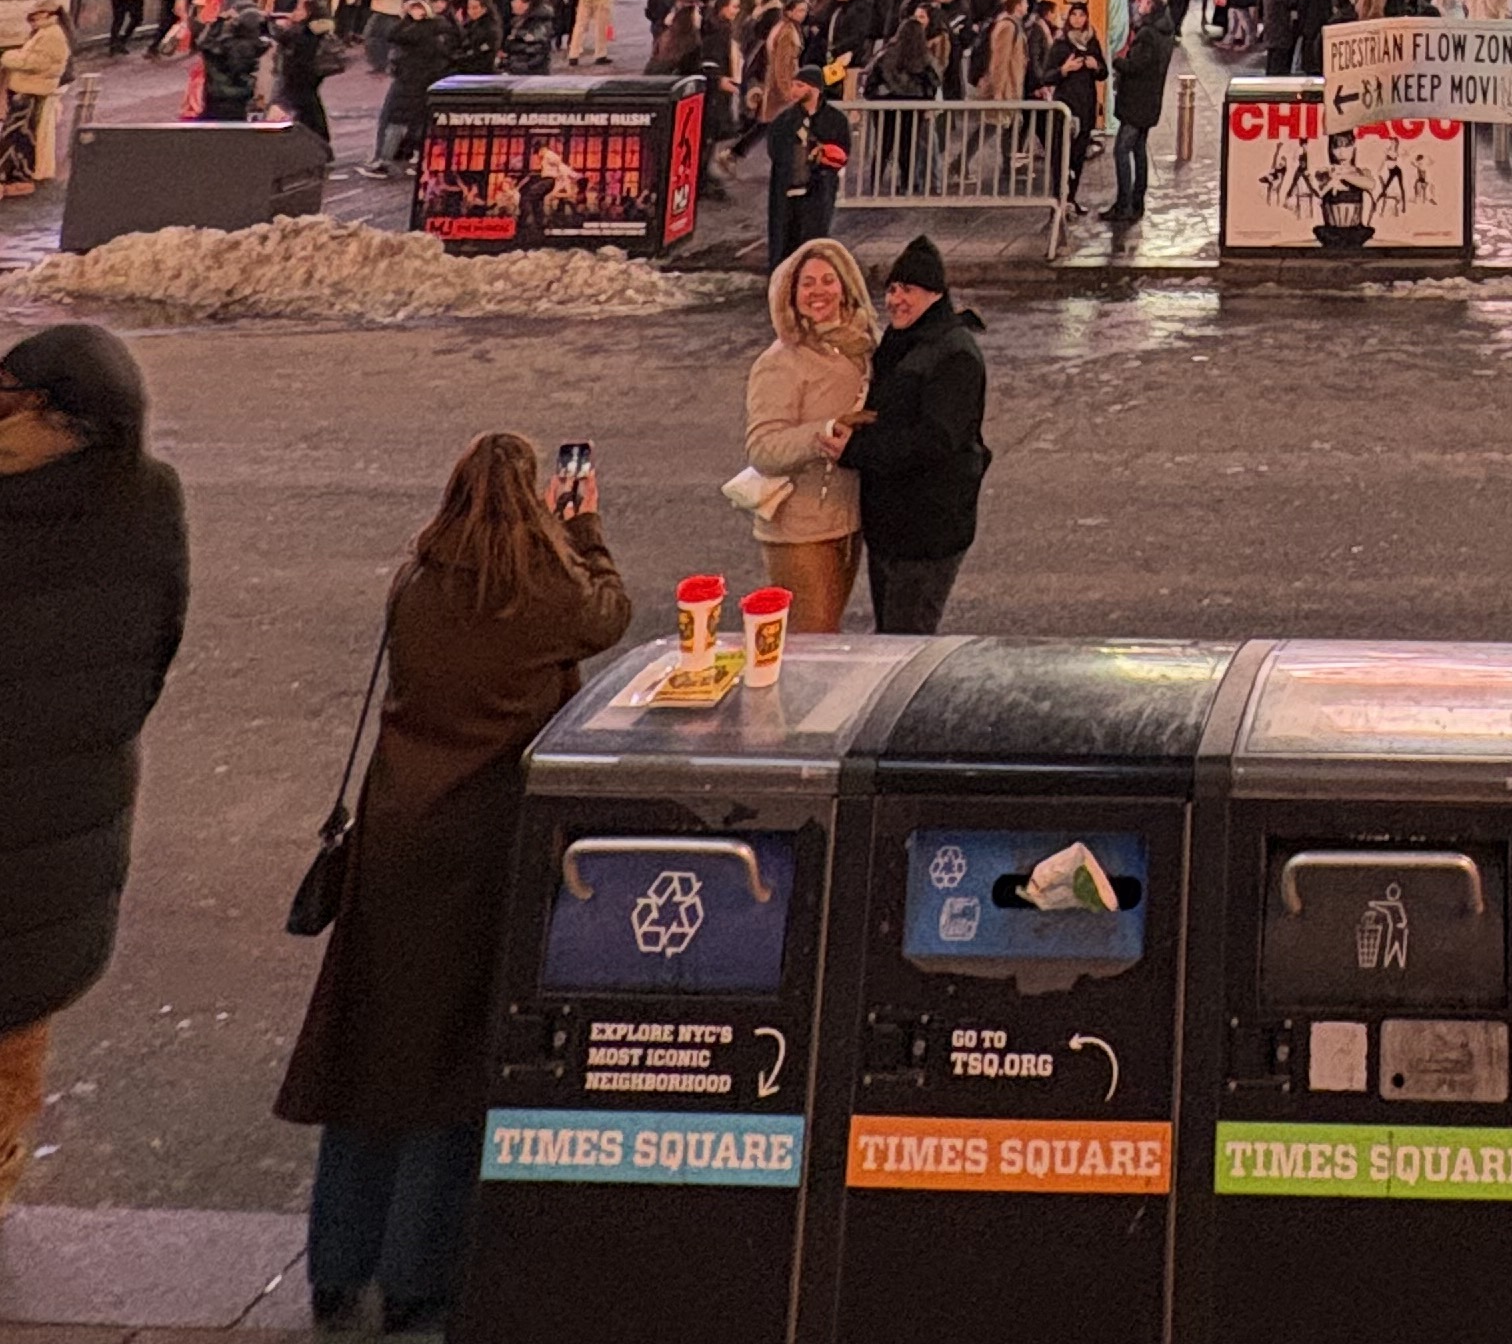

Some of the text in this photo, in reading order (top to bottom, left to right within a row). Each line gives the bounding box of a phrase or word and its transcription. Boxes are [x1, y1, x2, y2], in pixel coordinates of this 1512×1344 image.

[1330, 33, 1404, 72] PEDESTRIAN
[1411, 31, 1467, 63] FLOW
[1390, 73, 1442, 104] KEEP
[447, 112, 516, 126] RIVETING
[517, 113, 609, 126] ADRENALINE
[1230, 103, 1464, 140] CHIAGO
[589, 1022, 734, 1044] EXPLORE NYC'S
[952, 1029, 1006, 1049] GO TO
[586, 1047, 712, 1069] MOST ICONIC
[950, 1052, 1053, 1078] TSQ.ORG
[584, 1071, 733, 1094] NEIGHBORHOOD
[494, 1127, 795, 1172] TIMES SQUARE
[858, 1134, 1163, 1178] TIMES SQUARE
[1224, 1140, 1358, 1179] TIMES
